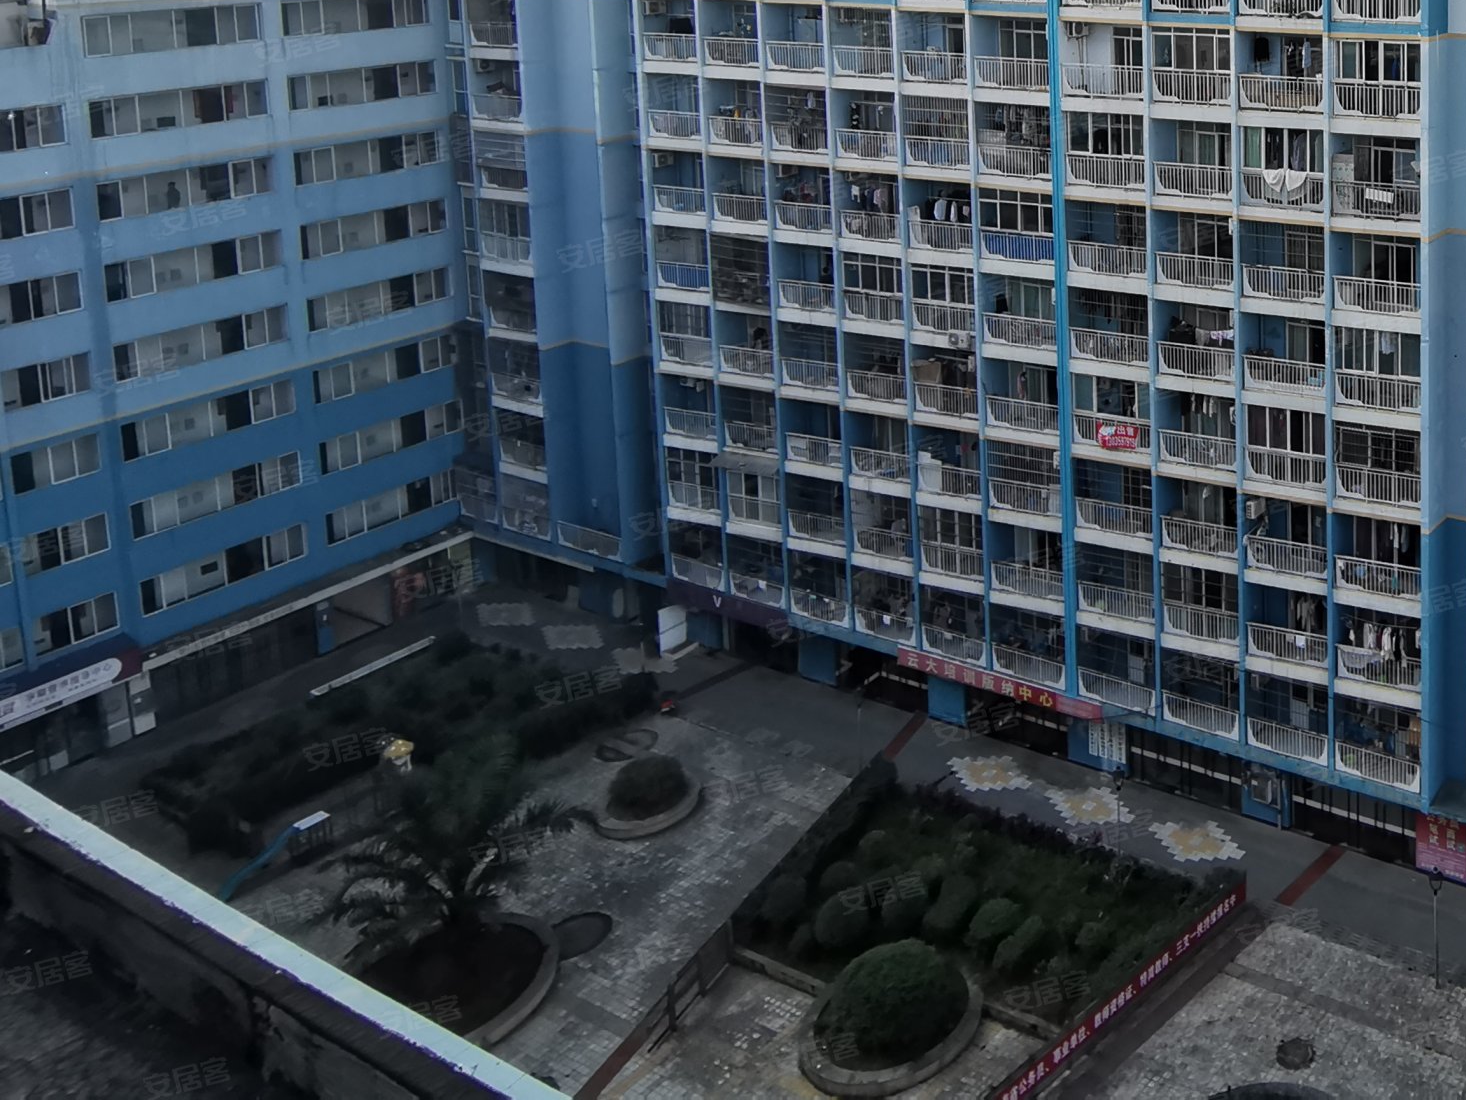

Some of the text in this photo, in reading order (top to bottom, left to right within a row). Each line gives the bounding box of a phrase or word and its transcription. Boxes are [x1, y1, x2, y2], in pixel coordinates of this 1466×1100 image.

[905, 654, 1053, 708] 云大培训版纳中心
